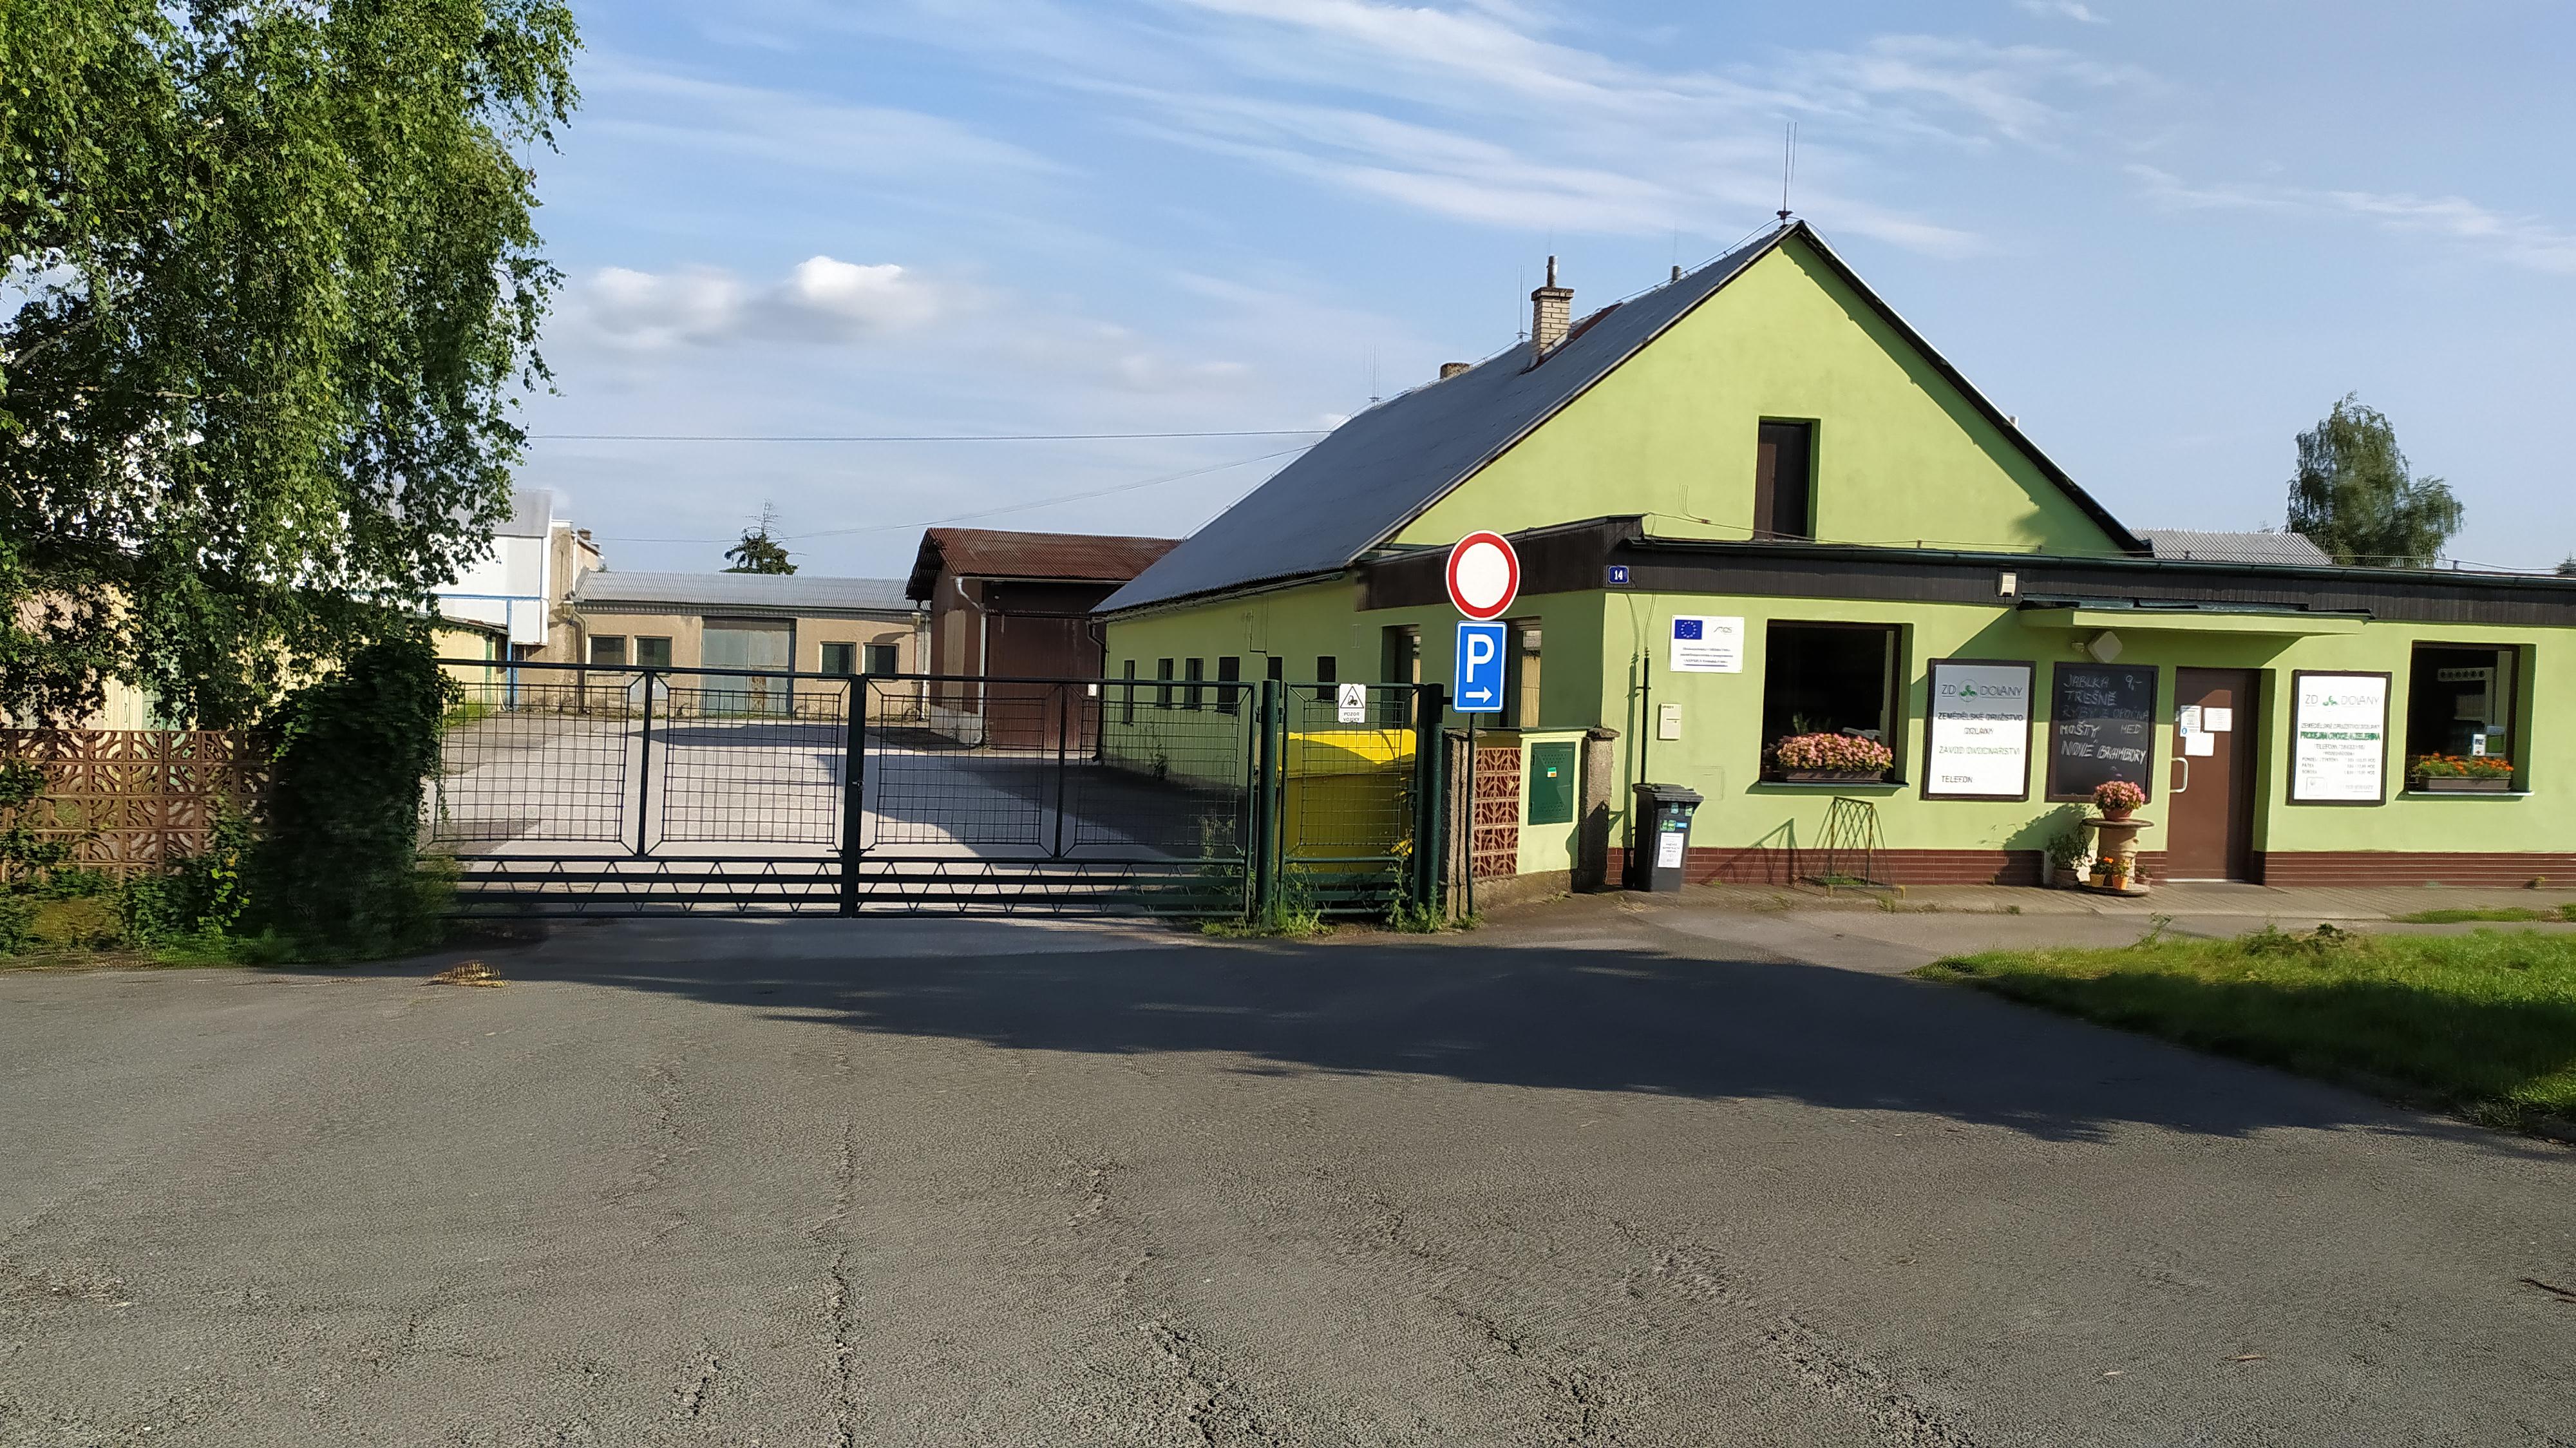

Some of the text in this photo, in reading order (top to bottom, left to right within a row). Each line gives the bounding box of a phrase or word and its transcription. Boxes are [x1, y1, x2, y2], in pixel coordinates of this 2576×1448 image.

[1615, 570, 1623, 580] 14
[1466, 634, 1494, 683] P
[2063, 674, 2110, 689] JABLKA
[1941, 684, 1956, 695] ZD
[2305, 694, 2318, 704] ZD
[2060, 720, 2143, 738] MOŠTY MED
[2061, 739, 2146, 765] NOVÉ BRAMBORY
